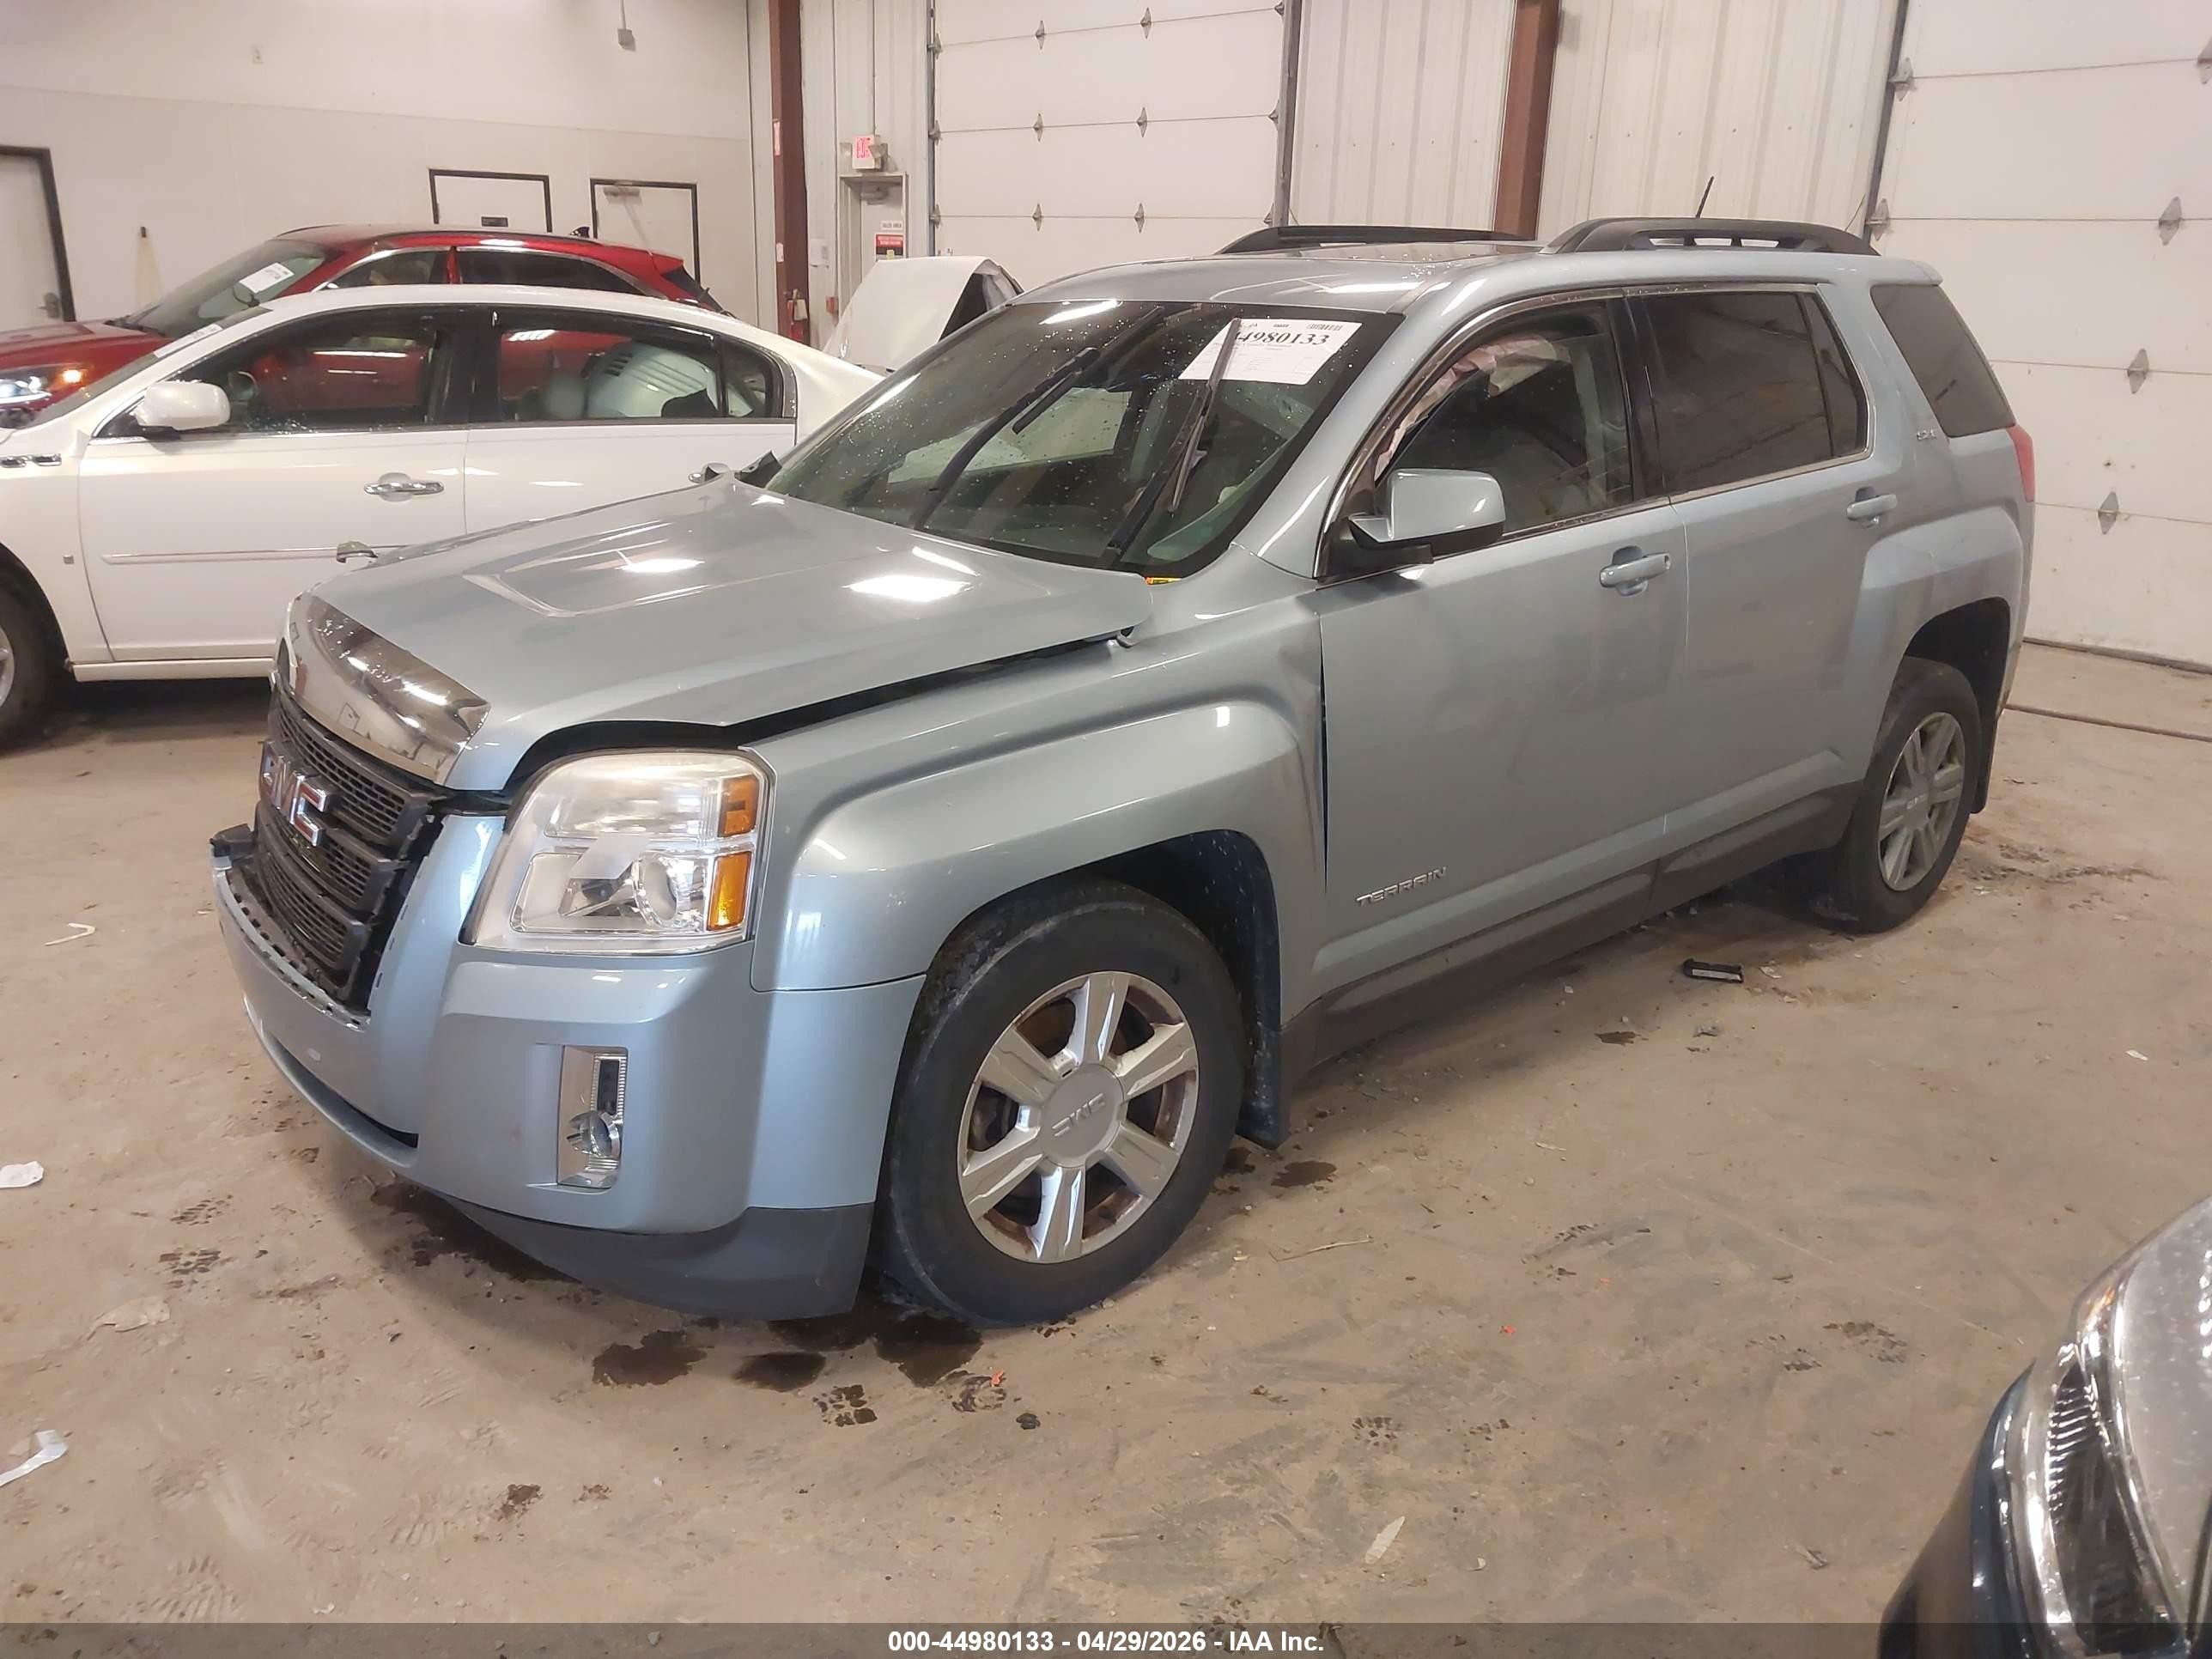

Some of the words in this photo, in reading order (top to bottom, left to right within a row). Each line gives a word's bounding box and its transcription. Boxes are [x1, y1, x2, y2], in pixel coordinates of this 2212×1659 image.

[259, 742, 327, 847] GMC
[1356, 866, 1447, 907] TERRAIN
[1051, 1092, 1106, 1137] GMC
